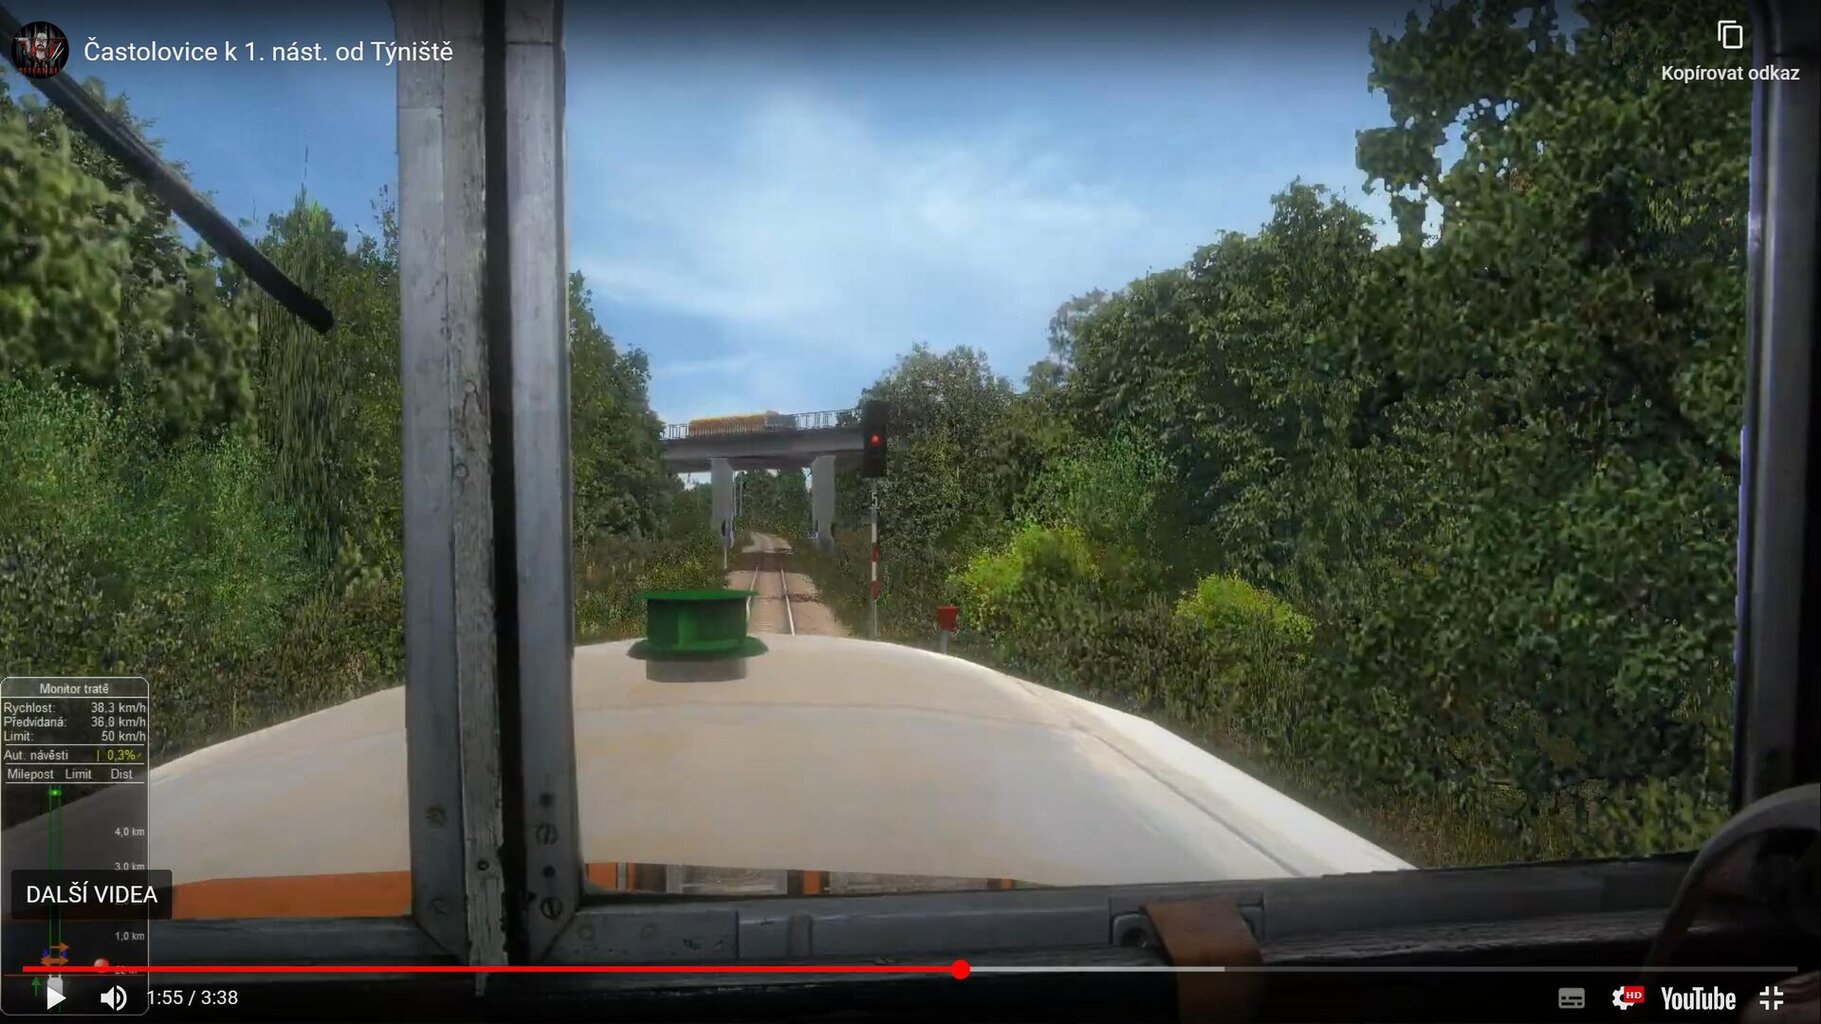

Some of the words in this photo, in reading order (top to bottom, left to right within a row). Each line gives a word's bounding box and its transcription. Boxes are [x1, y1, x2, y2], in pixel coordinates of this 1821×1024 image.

[40, 683, 81, 694] Monitor
[84, 683, 110, 694] tratě
[3, 702, 56, 715] Rychlost:
[118, 702, 147, 713] km/h
[118, 716, 147, 728] km/h
[3, 731, 34, 742] Limit:
[101, 731, 115, 742] 50
[118, 731, 147, 742] km/h
[3, 750, 27, 761] Aut.
[30, 750, 69, 761] návěsti
[7, 768, 55, 780] Milepost
[65, 768, 93, 780] Limit
[111, 768, 133, 780] Dist
[132, 827, 145, 837] km
[132, 931, 145, 941] km
